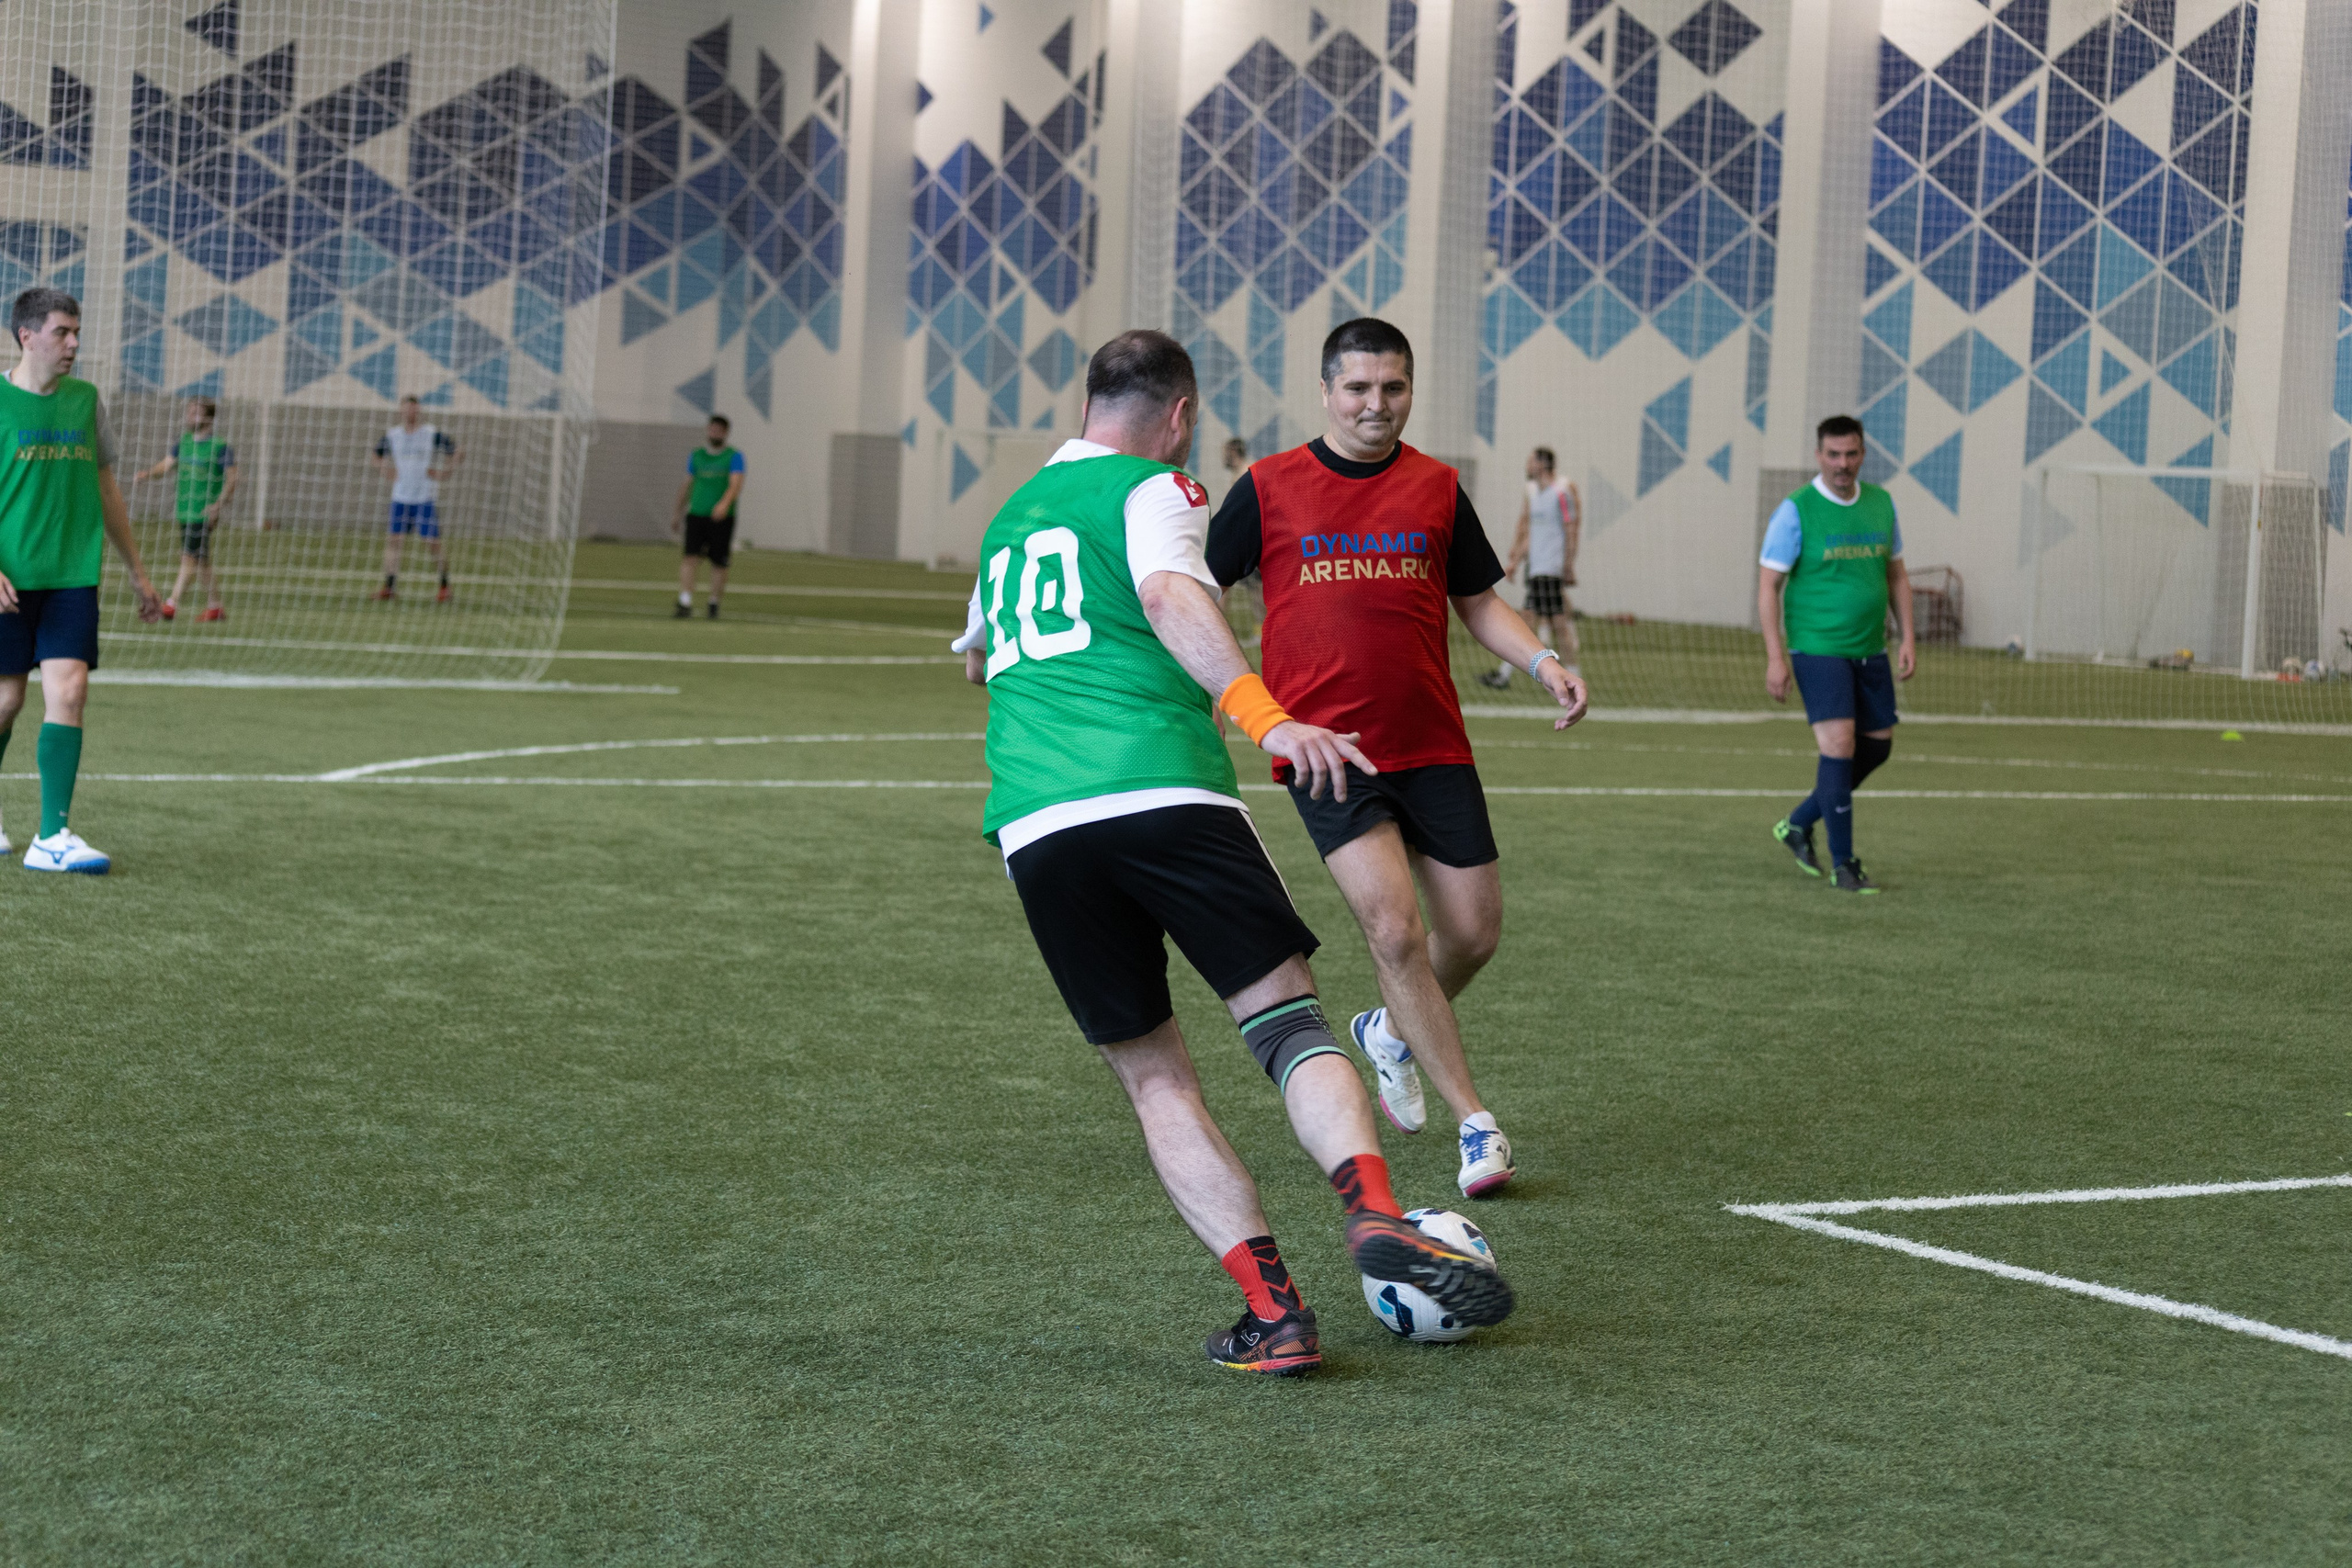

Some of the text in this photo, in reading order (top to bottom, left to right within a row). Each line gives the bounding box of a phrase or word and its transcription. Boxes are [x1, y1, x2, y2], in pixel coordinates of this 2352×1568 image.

[1301, 532, 1427, 558] DYNAMO
[1299, 558, 1431, 586] ARENA.RU
[986, 526, 1091, 683] 10
